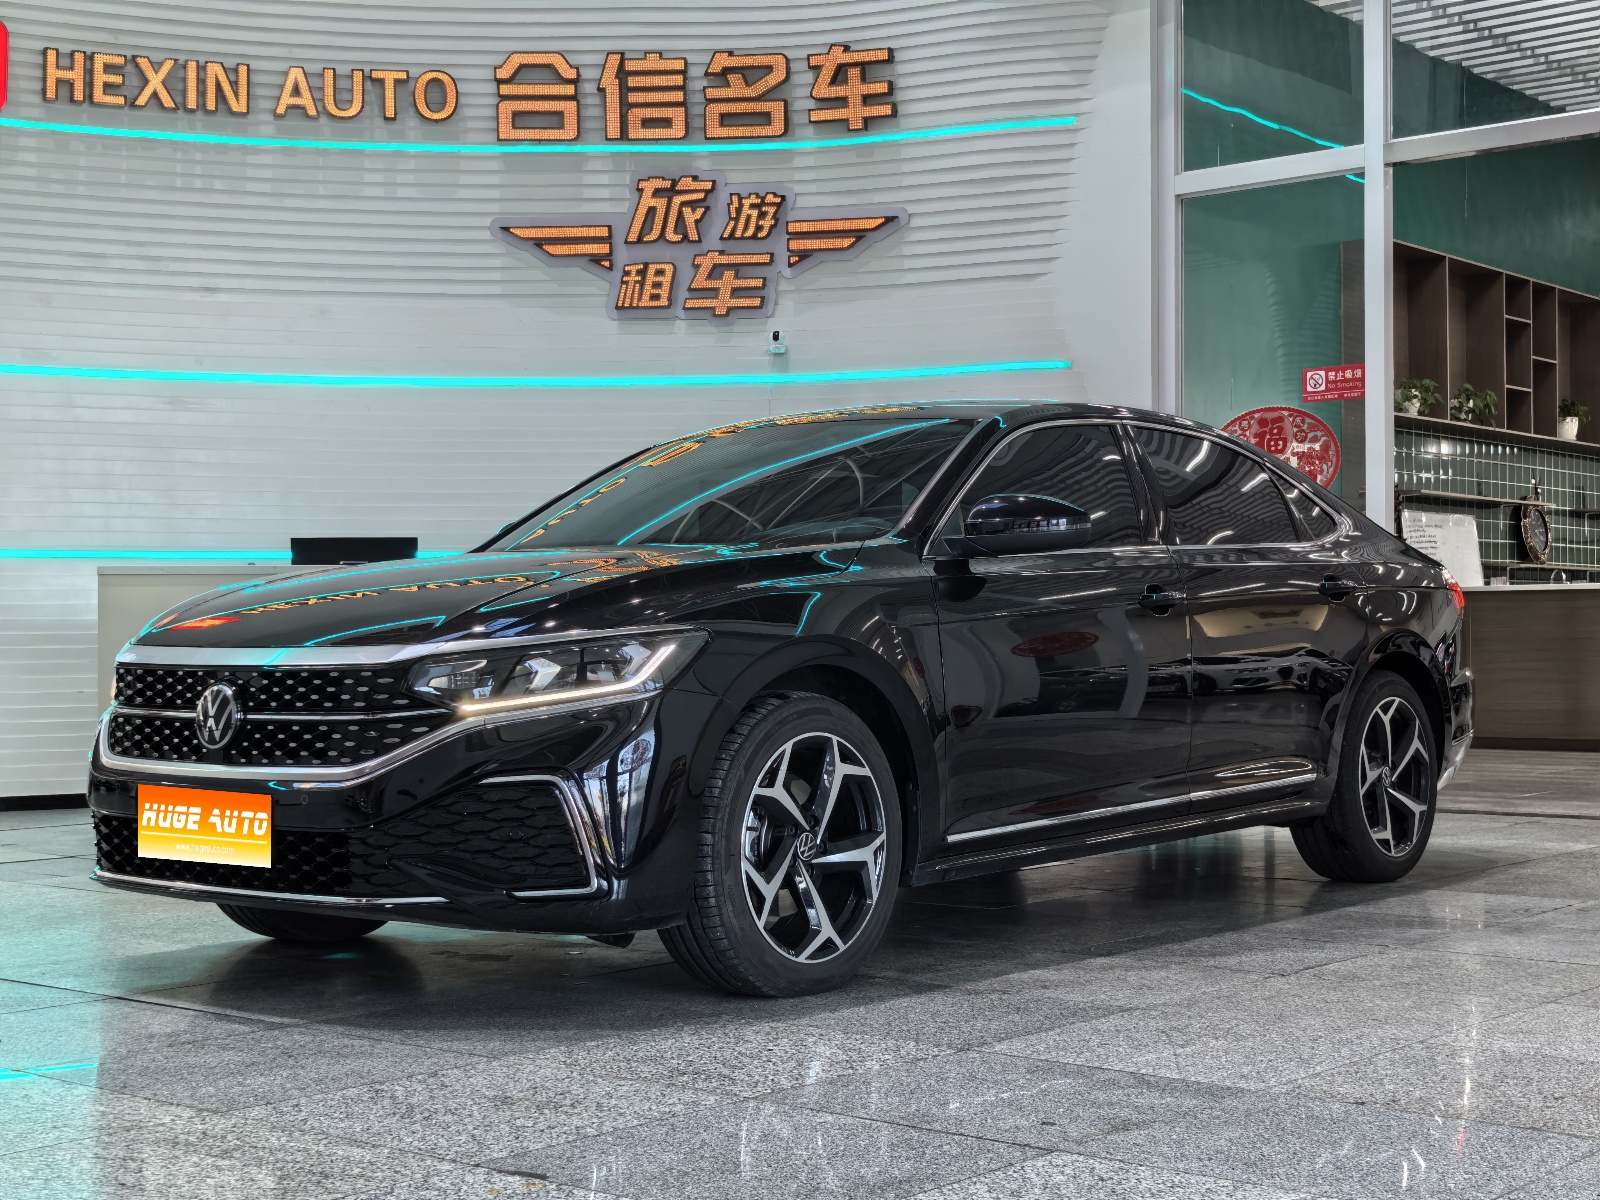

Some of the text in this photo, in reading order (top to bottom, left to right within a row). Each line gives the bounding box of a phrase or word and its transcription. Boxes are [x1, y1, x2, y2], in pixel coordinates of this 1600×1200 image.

[43, 47, 459, 123] HEXIN AUTO
[494, 44, 897, 142] 合信名车
[624, 174, 786, 244] 旅游
[615, 250, 774, 317] 租车
[1327, 368, 1362, 381] 禁止吸烟
[1336, 380, 1362, 388] Smoking
[141, 802, 269, 836] HUGE AUTO
